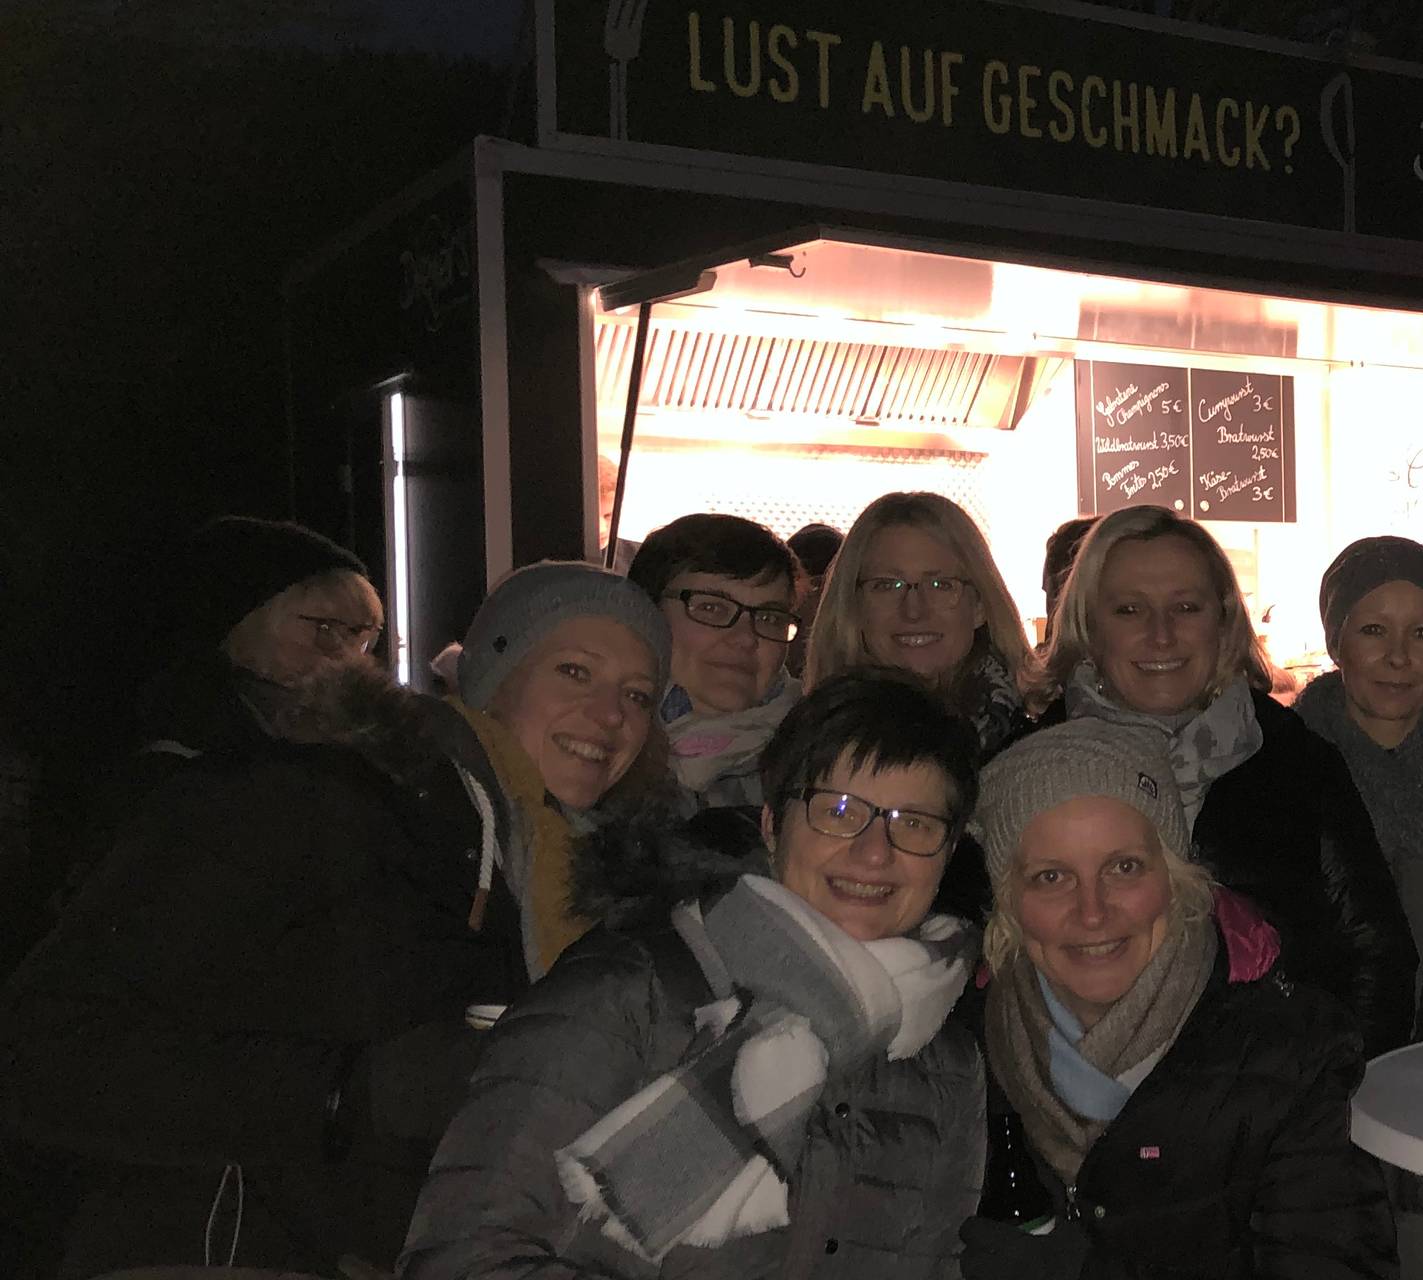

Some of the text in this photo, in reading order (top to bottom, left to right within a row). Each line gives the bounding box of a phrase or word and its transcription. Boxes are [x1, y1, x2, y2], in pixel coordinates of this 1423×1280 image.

[688, 11, 1301, 174] LUST AUF GESCHMACK?
[1116, 382, 1170, 424] Champignons
[1198, 375, 1254, 423] Currywurst
[1216, 423, 1275, 443] Bratwurst
[1102, 460, 1139, 490] Pommes
[1119, 473, 1147, 499] Frites
[1216, 465, 1267, 502] Bratwurst
